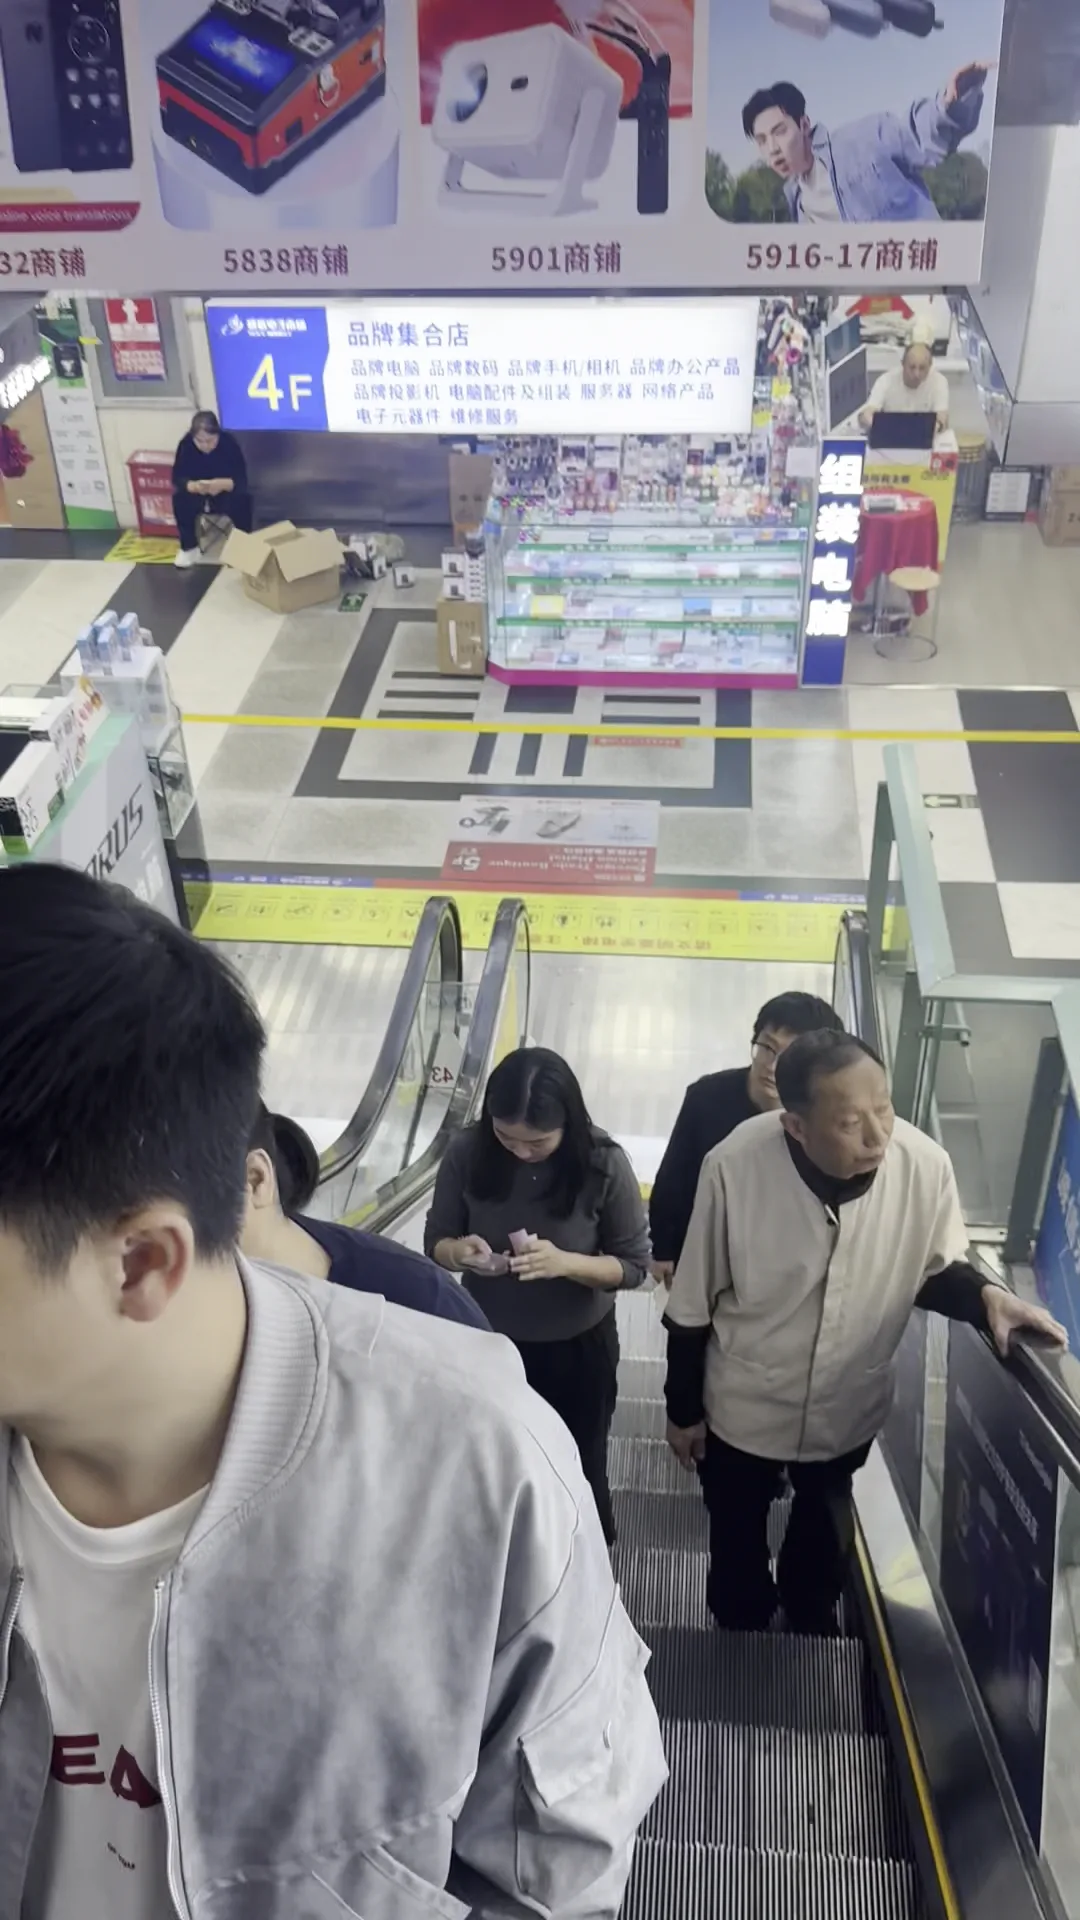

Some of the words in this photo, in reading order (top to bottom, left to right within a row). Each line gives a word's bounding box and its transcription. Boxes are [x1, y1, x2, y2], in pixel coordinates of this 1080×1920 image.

[223, 244, 348, 276] 5838商铺
[491, 242, 621, 274] 5901商铺
[747, 238, 938, 271] 5916-17商铺
[348, 321, 469, 347] 品牌集合店
[351, 359, 420, 377] 品牌电脑
[429, 359, 498, 377] 品牌数码
[630, 357, 740, 376] 品牌办公产品
[247, 353, 313, 412] 4F
[354, 384, 440, 401] 品牌投影机
[449, 383, 571, 401] 电脑配件及组装
[580, 383, 632, 400] 服务器
[642, 382, 714, 400] 网络产品
[356, 408, 440, 425] 电子元器件
[450, 408, 518, 425] 维修服务
